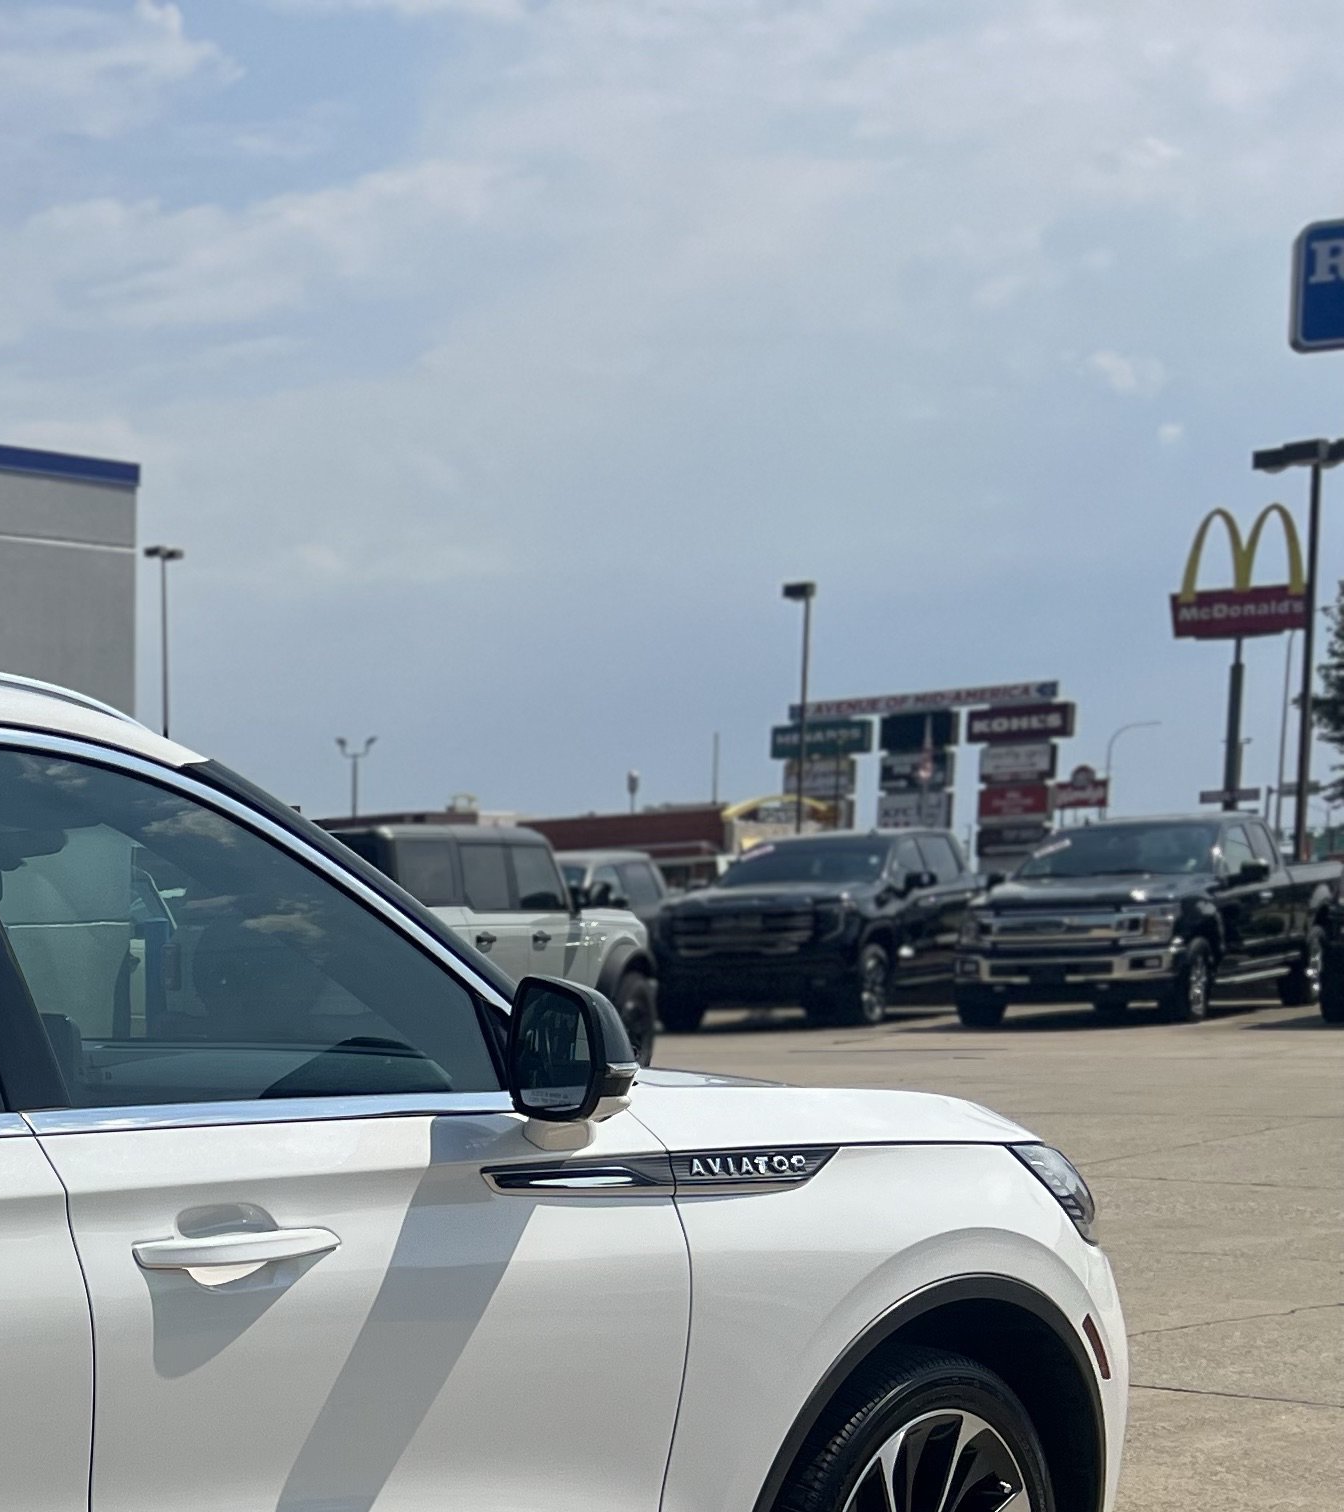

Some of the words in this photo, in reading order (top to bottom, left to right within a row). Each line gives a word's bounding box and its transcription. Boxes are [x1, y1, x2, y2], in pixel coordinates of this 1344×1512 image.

[1178, 602, 1305, 622] McDonald's
[972, 713, 1061, 733] KOHL'S
[691, 1154, 808, 1176] AVIATOR
